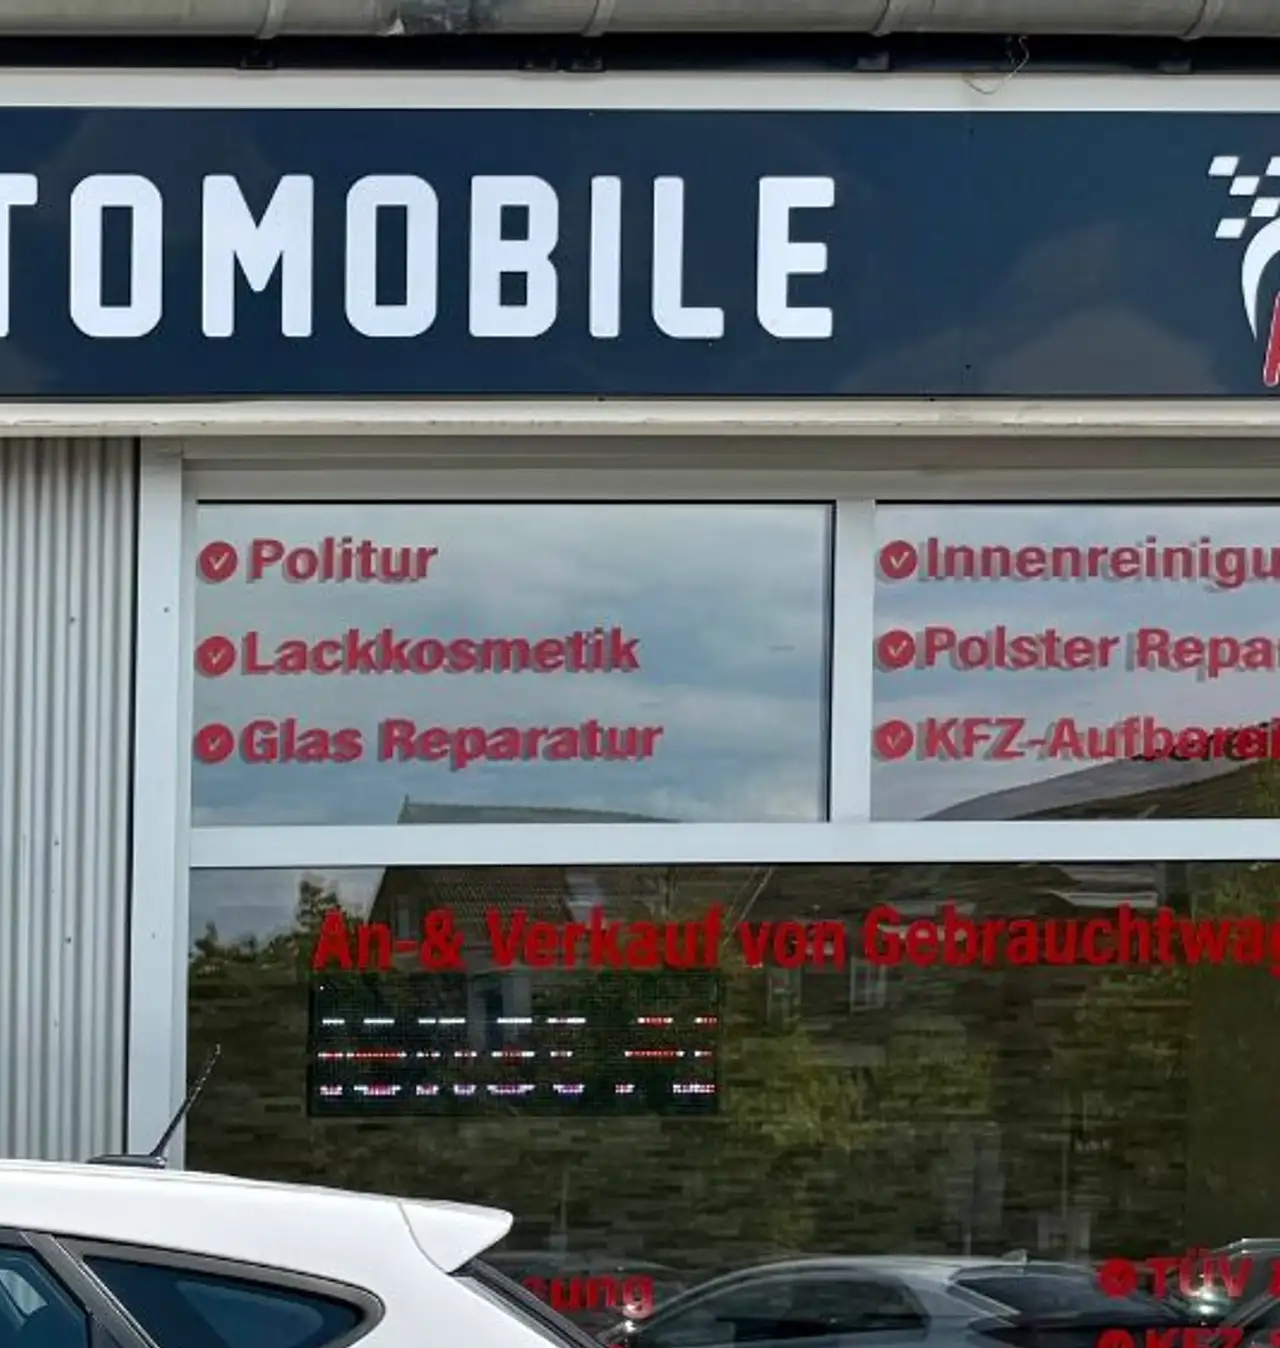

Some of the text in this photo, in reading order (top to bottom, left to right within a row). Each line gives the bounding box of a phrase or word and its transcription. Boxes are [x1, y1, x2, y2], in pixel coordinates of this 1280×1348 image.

[251, 537, 438, 580] Politur
[927, 537, 1280, 588] Innenreinigu
[244, 628, 640, 673] Lackkosmetik
[924, 626, 1119, 668] Polster
[242, 718, 662, 769] Glas Reparatur
[486, 901, 724, 970] Verkauf
[738, 918, 847, 970] von
[861, 902, 1280, 980] Gebrauchtwa
[1145, 1246, 1254, 1299] TÜV
